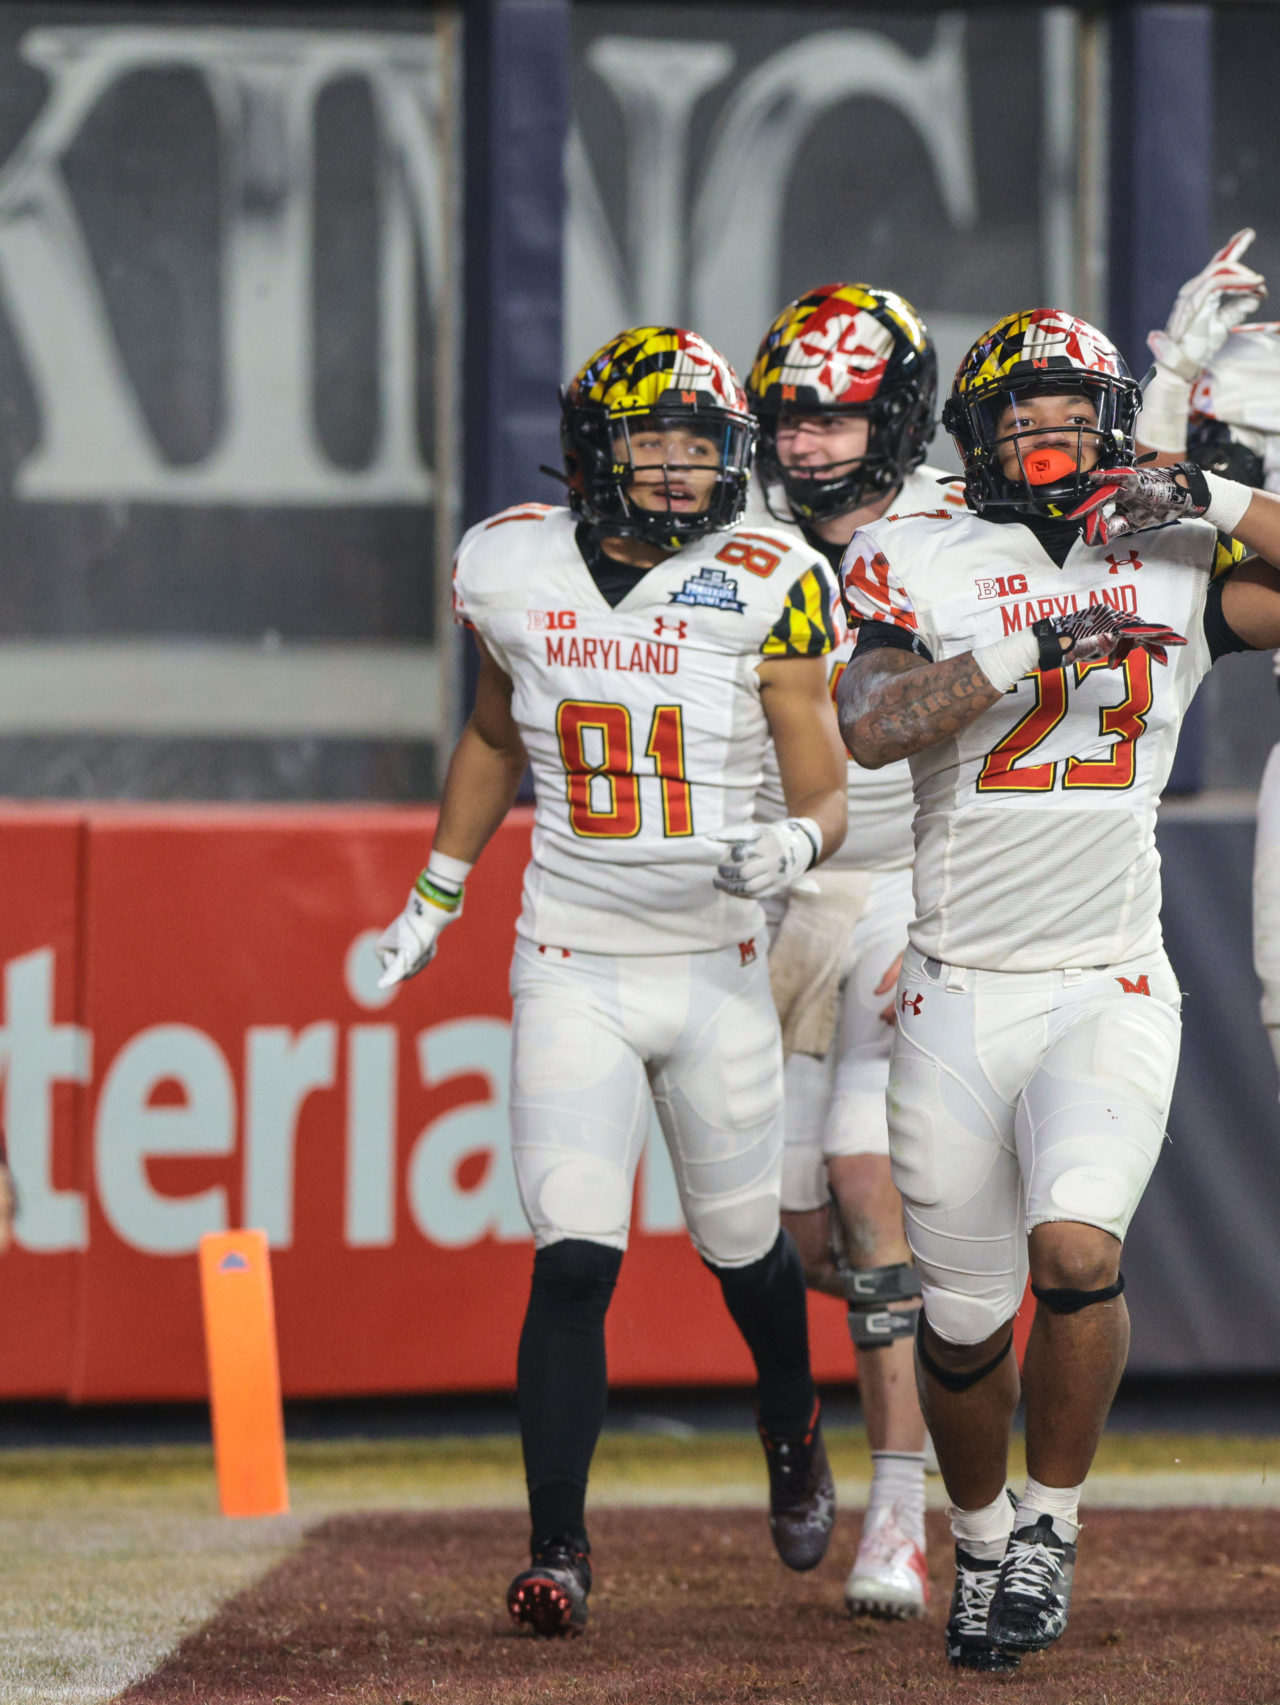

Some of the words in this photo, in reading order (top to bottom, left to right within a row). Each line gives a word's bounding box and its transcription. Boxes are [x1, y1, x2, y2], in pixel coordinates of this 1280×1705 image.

[545, 636, 679, 675] MARYLAND
[976, 645, 1152, 794] 23
[557, 698, 694, 839] 81
